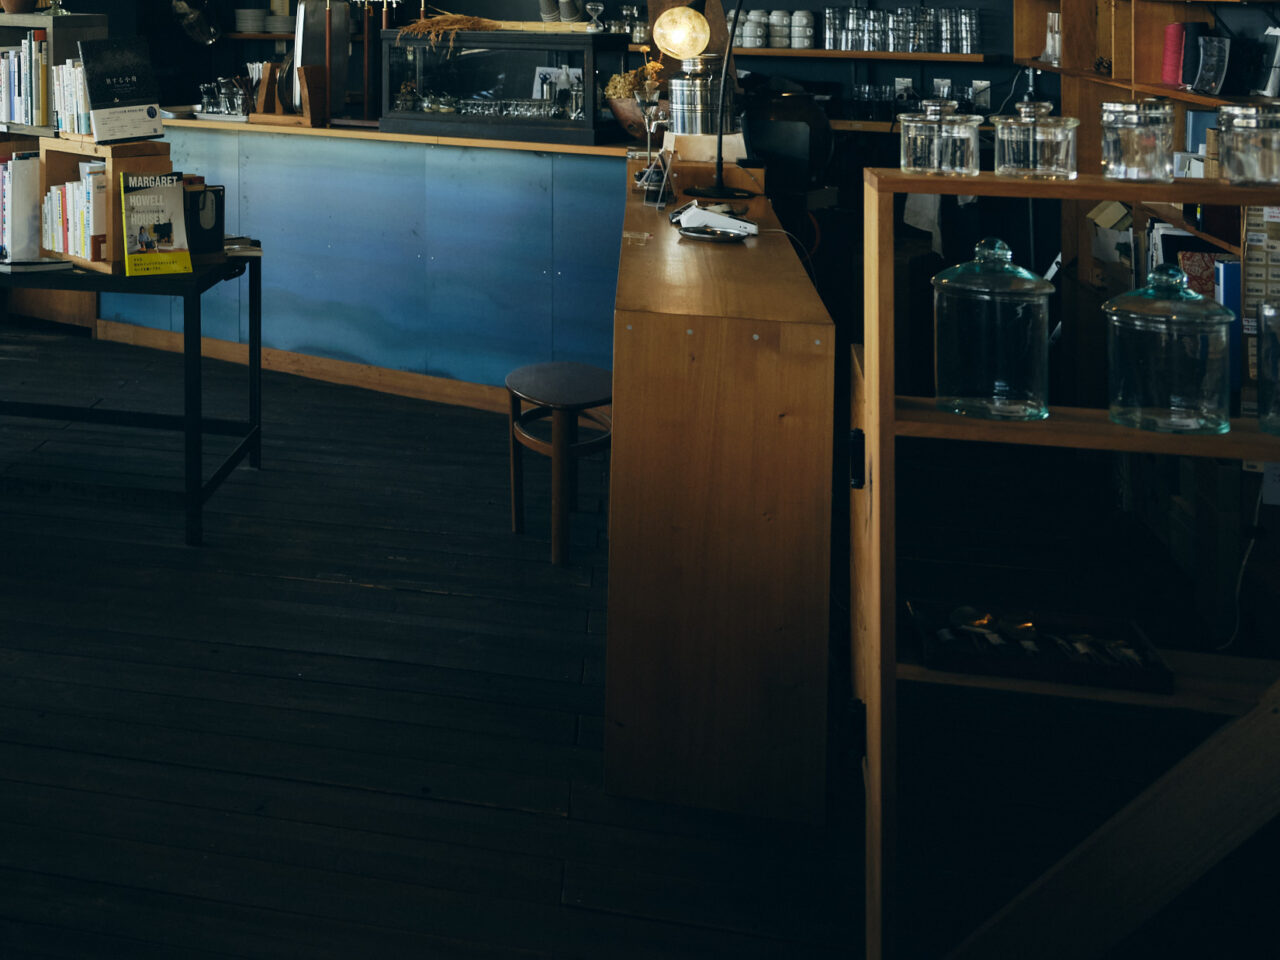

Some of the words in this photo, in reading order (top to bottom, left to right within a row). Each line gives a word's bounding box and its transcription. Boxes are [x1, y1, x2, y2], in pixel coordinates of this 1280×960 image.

[128, 176, 178, 188] MARGARET
[129, 195, 164, 206] HOWELL
[131, 213, 166, 225] HOUSES
